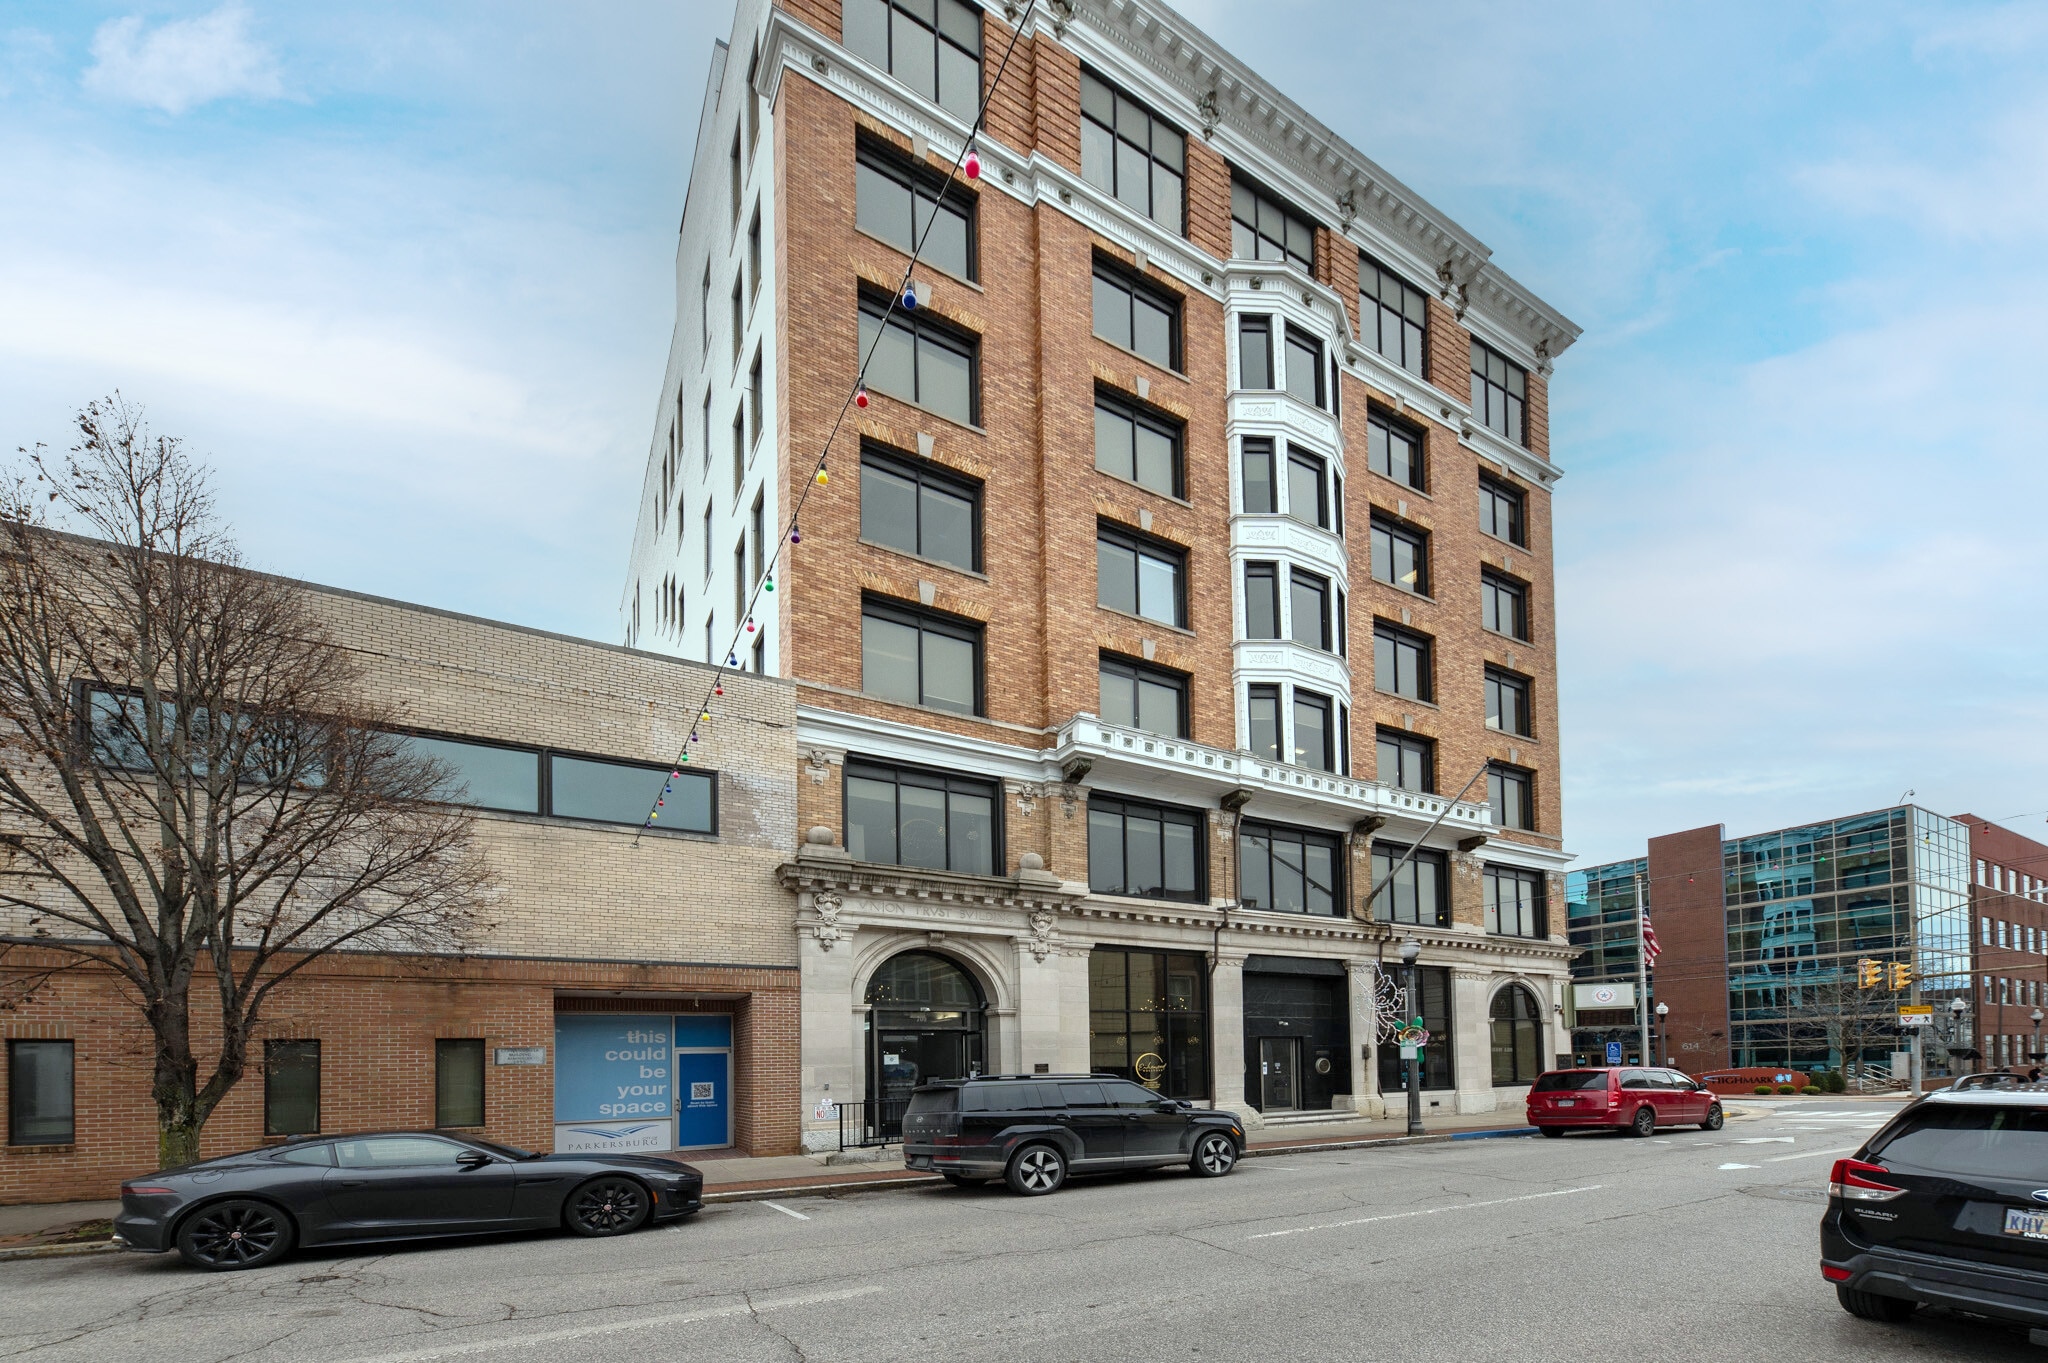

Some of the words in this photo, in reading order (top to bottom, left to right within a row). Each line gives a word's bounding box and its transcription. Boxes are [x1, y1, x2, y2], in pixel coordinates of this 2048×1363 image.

[626, 1030, 666, 1044] this
[1681, 1042, 1699, 1050] 614
[605, 1047, 666, 1061] could
[640, 1065, 666, 1078] be
[1711, 1075, 1774, 1084] HIGHMARK
[617, 1084, 667, 1099] your
[599, 1101, 666, 1117] space
[816, 1110, 825, 1119] NO
[568, 1139, 658, 1151] PARKERSBURG
[1854, 1207, 1898, 1219] SUBARU
